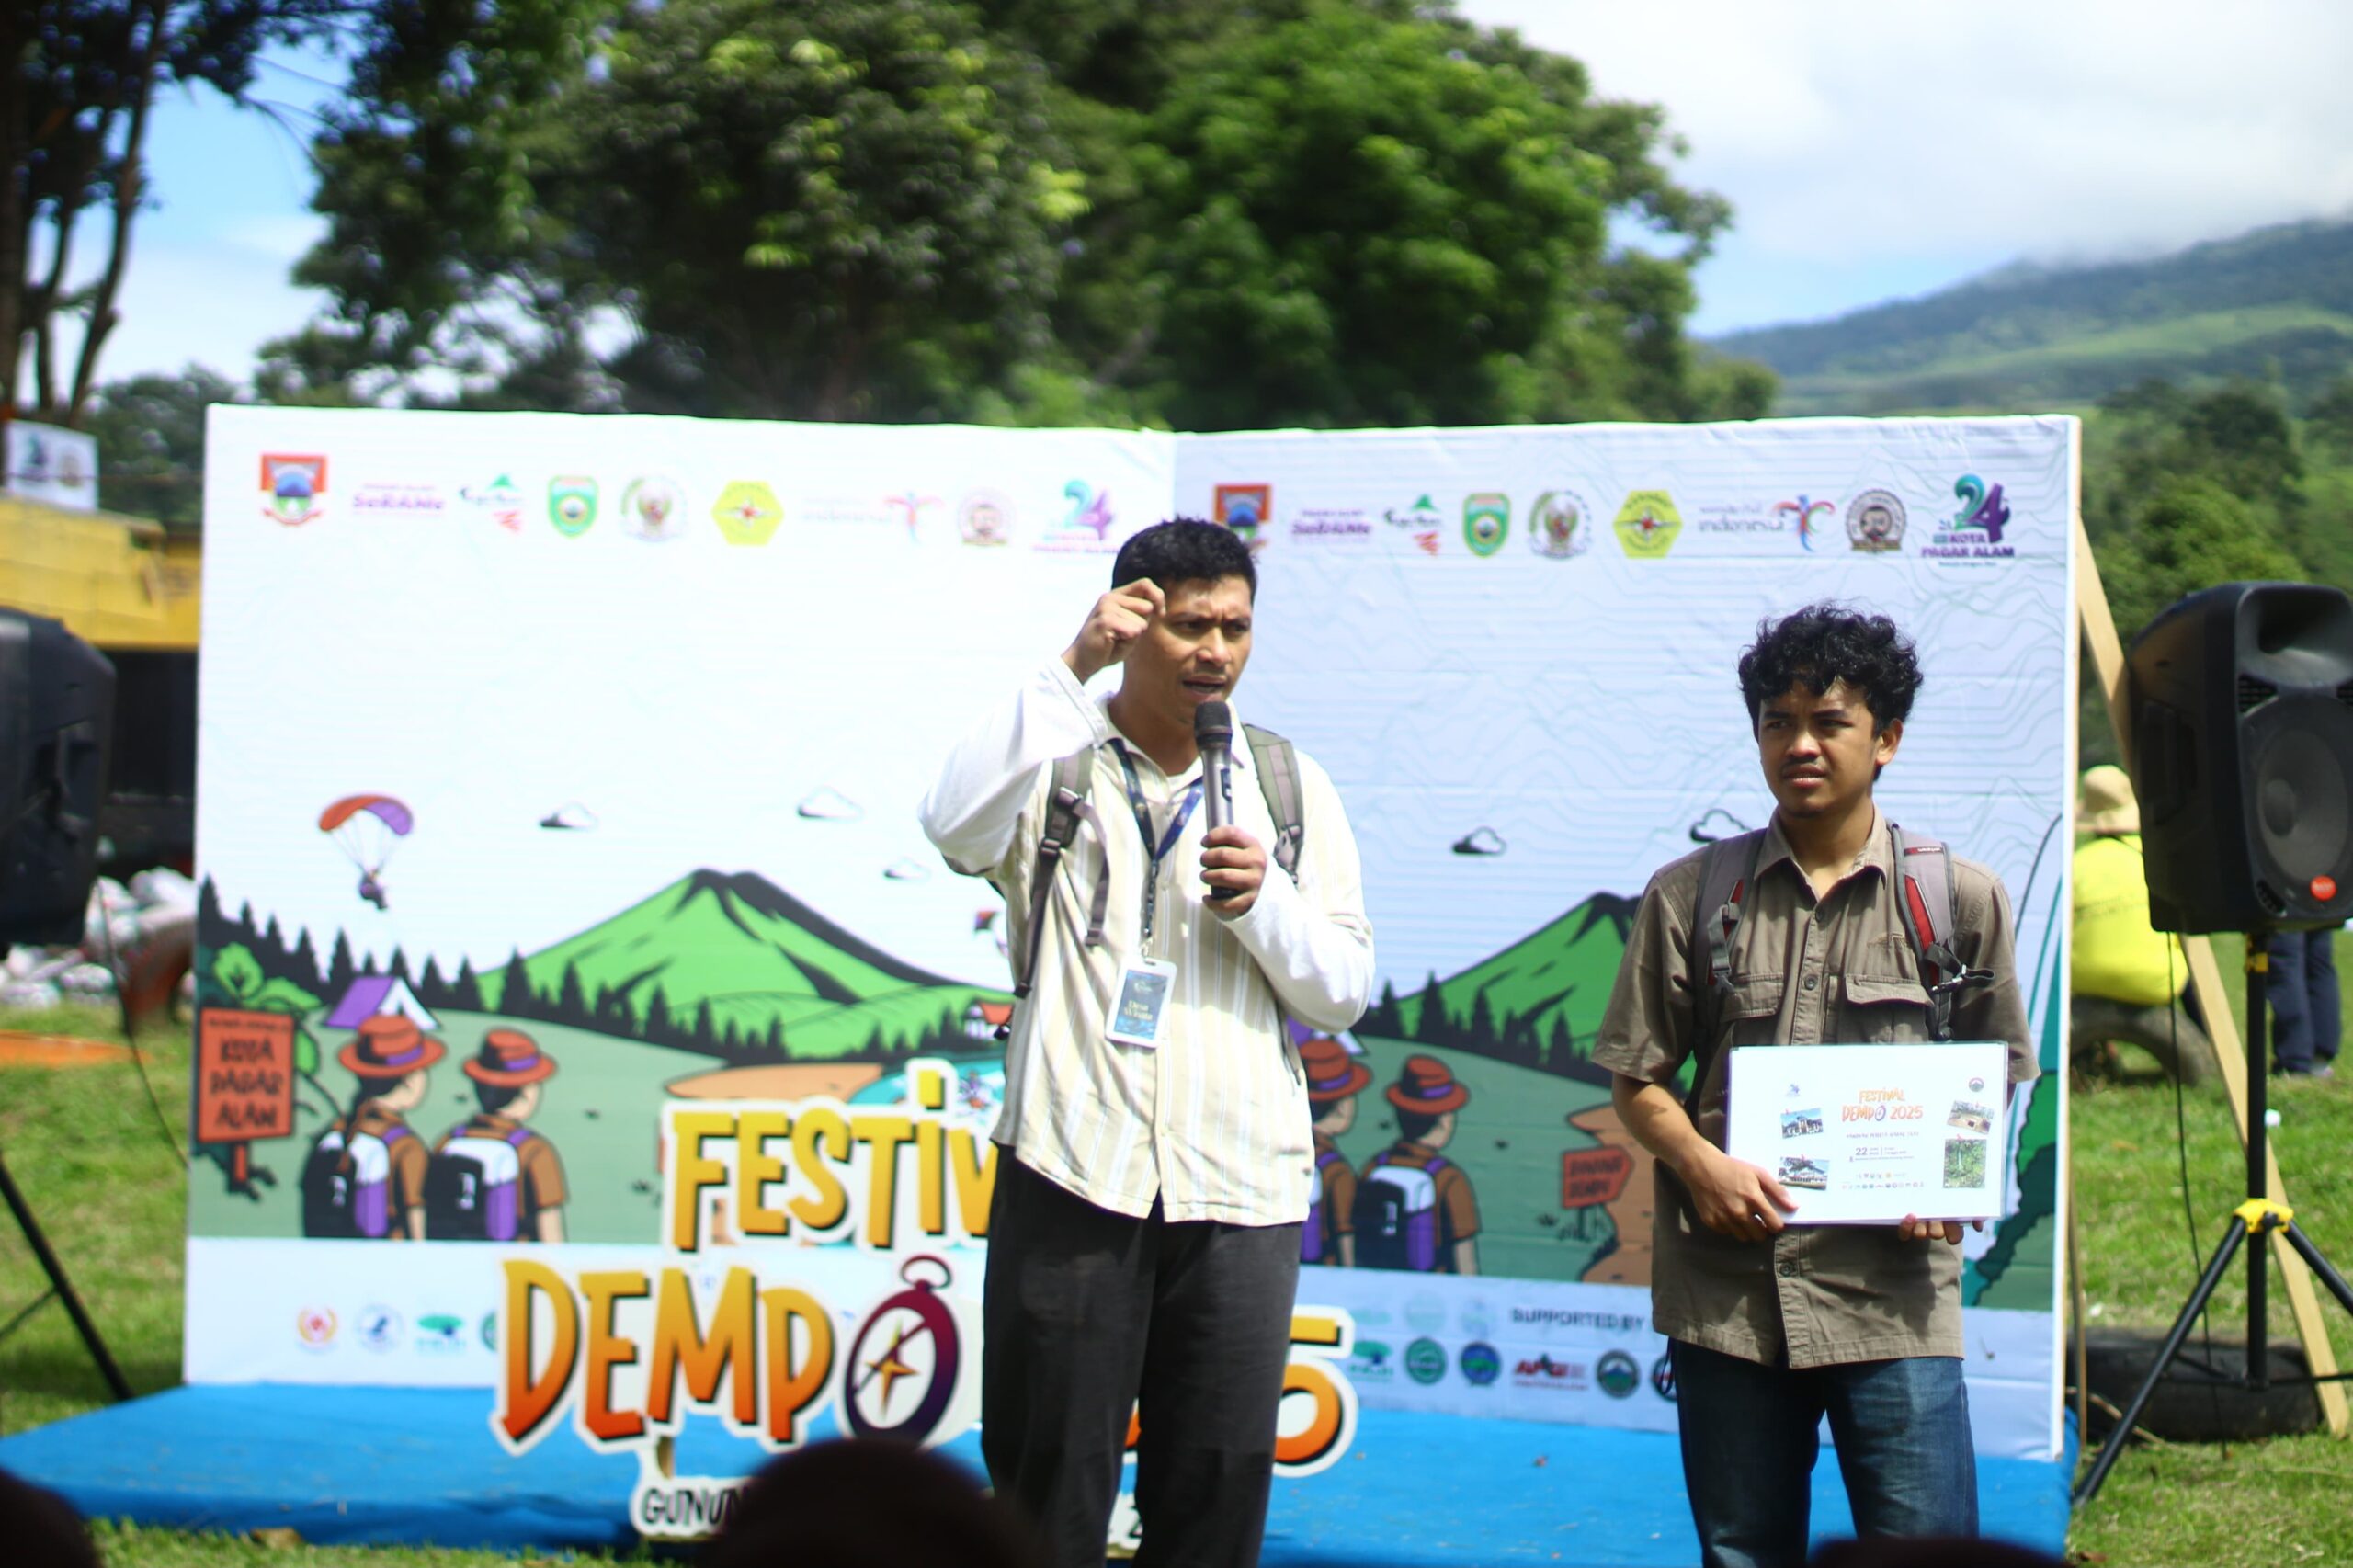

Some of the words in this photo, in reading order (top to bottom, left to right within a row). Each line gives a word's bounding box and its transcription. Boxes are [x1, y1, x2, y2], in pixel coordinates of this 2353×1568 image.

[1954, 474, 2011, 544] 24
[1972, 546, 2015, 558] ALAM
[1890, 1106, 1923, 1119] 2025
[1855, 1146, 1868, 1156] 22
[671, 1069, 999, 1254] FESTIV
[1511, 1308, 1618, 1329] SUPPORTED
[1620, 1314, 1645, 1331] BY
